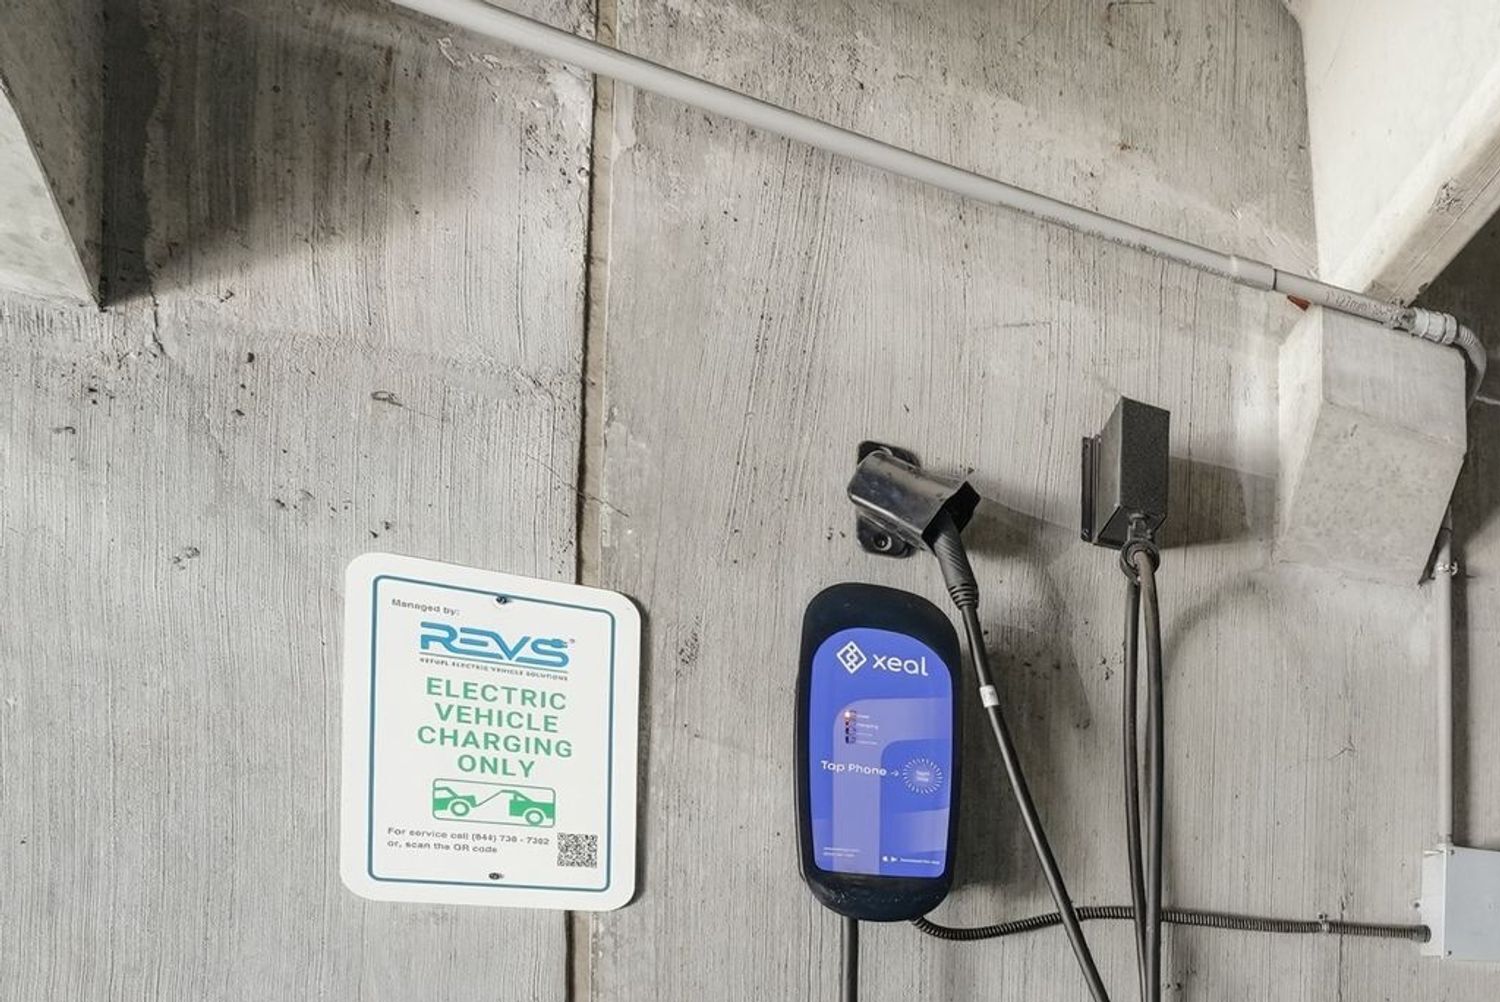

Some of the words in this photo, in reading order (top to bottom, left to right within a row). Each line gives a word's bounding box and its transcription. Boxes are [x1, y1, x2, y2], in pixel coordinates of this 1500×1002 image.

[391, 598, 440, 612] Managed
[420, 621, 570, 668] REVS
[526, 670, 568, 681] SOLUTIONS
[872, 654, 929, 677] xeal
[426, 676, 567, 711] ELECTRIC
[434, 702, 559, 733] VEHICLE
[417, 726, 573, 758] CHARGING
[457, 754, 535, 778] ONLY
[820, 760, 845, 773] Tap
[848, 763, 887, 777] Phone
[387, 827, 406, 836] For
[408, 830, 449, 838] service
[450, 832, 469, 840] call
[387, 840, 402, 848] or,
[433, 842, 450, 850] the
[453, 844, 470, 852] QR
